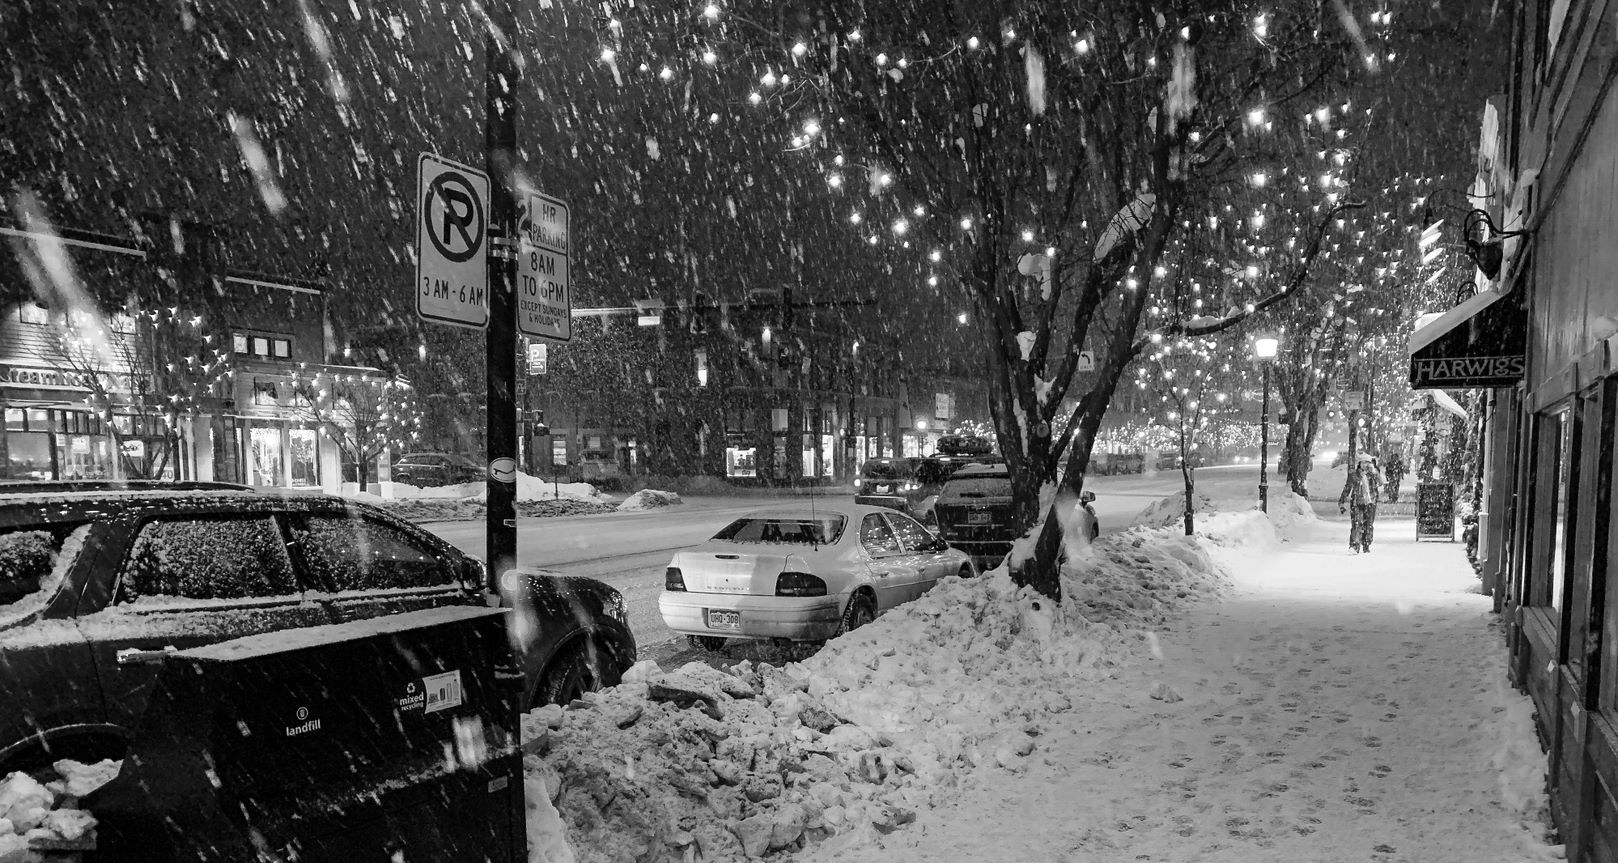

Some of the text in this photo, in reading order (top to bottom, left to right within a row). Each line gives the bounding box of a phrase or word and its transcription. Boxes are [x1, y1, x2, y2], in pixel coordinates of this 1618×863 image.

[542, 203, 557, 224] HR
[532, 223, 566, 250] PARKING
[530, 251, 555, 276] 8AM
[423, 276, 430, 296] 3
[433, 278, 449, 300] AM
[459, 285, 466, 303] 6
[469, 286, 483, 307] AM
[522, 274, 564, 303] TO 6PM
[520, 299, 567, 319] EXCEPT SUNDAYS
[528, 312, 561, 328] & HOLIDAYS
[399, 691, 424, 706] mixed
[401, 701, 424, 711] recycling
[286, 717, 321, 737] landfill
